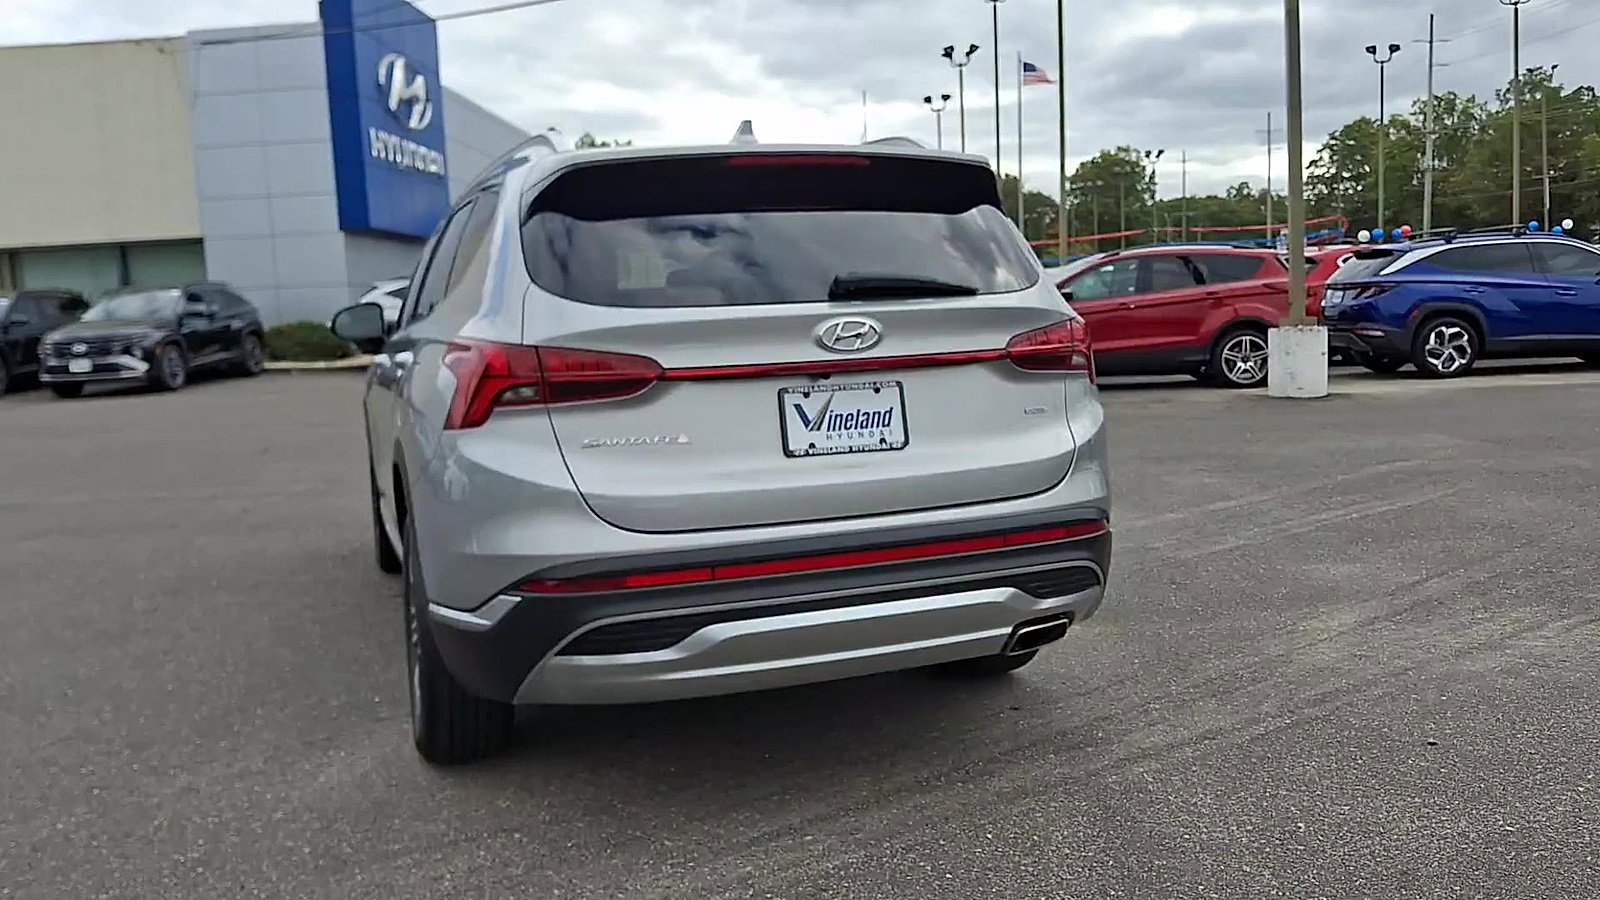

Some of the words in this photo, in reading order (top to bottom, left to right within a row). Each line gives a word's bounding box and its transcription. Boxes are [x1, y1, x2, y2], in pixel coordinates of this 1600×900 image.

[369, 127, 445, 176] HYUNDAI
[792, 392, 894, 432] Vineland
[581, 437, 650, 449] SANTA
[826, 430, 893, 441] HYUNDAI
